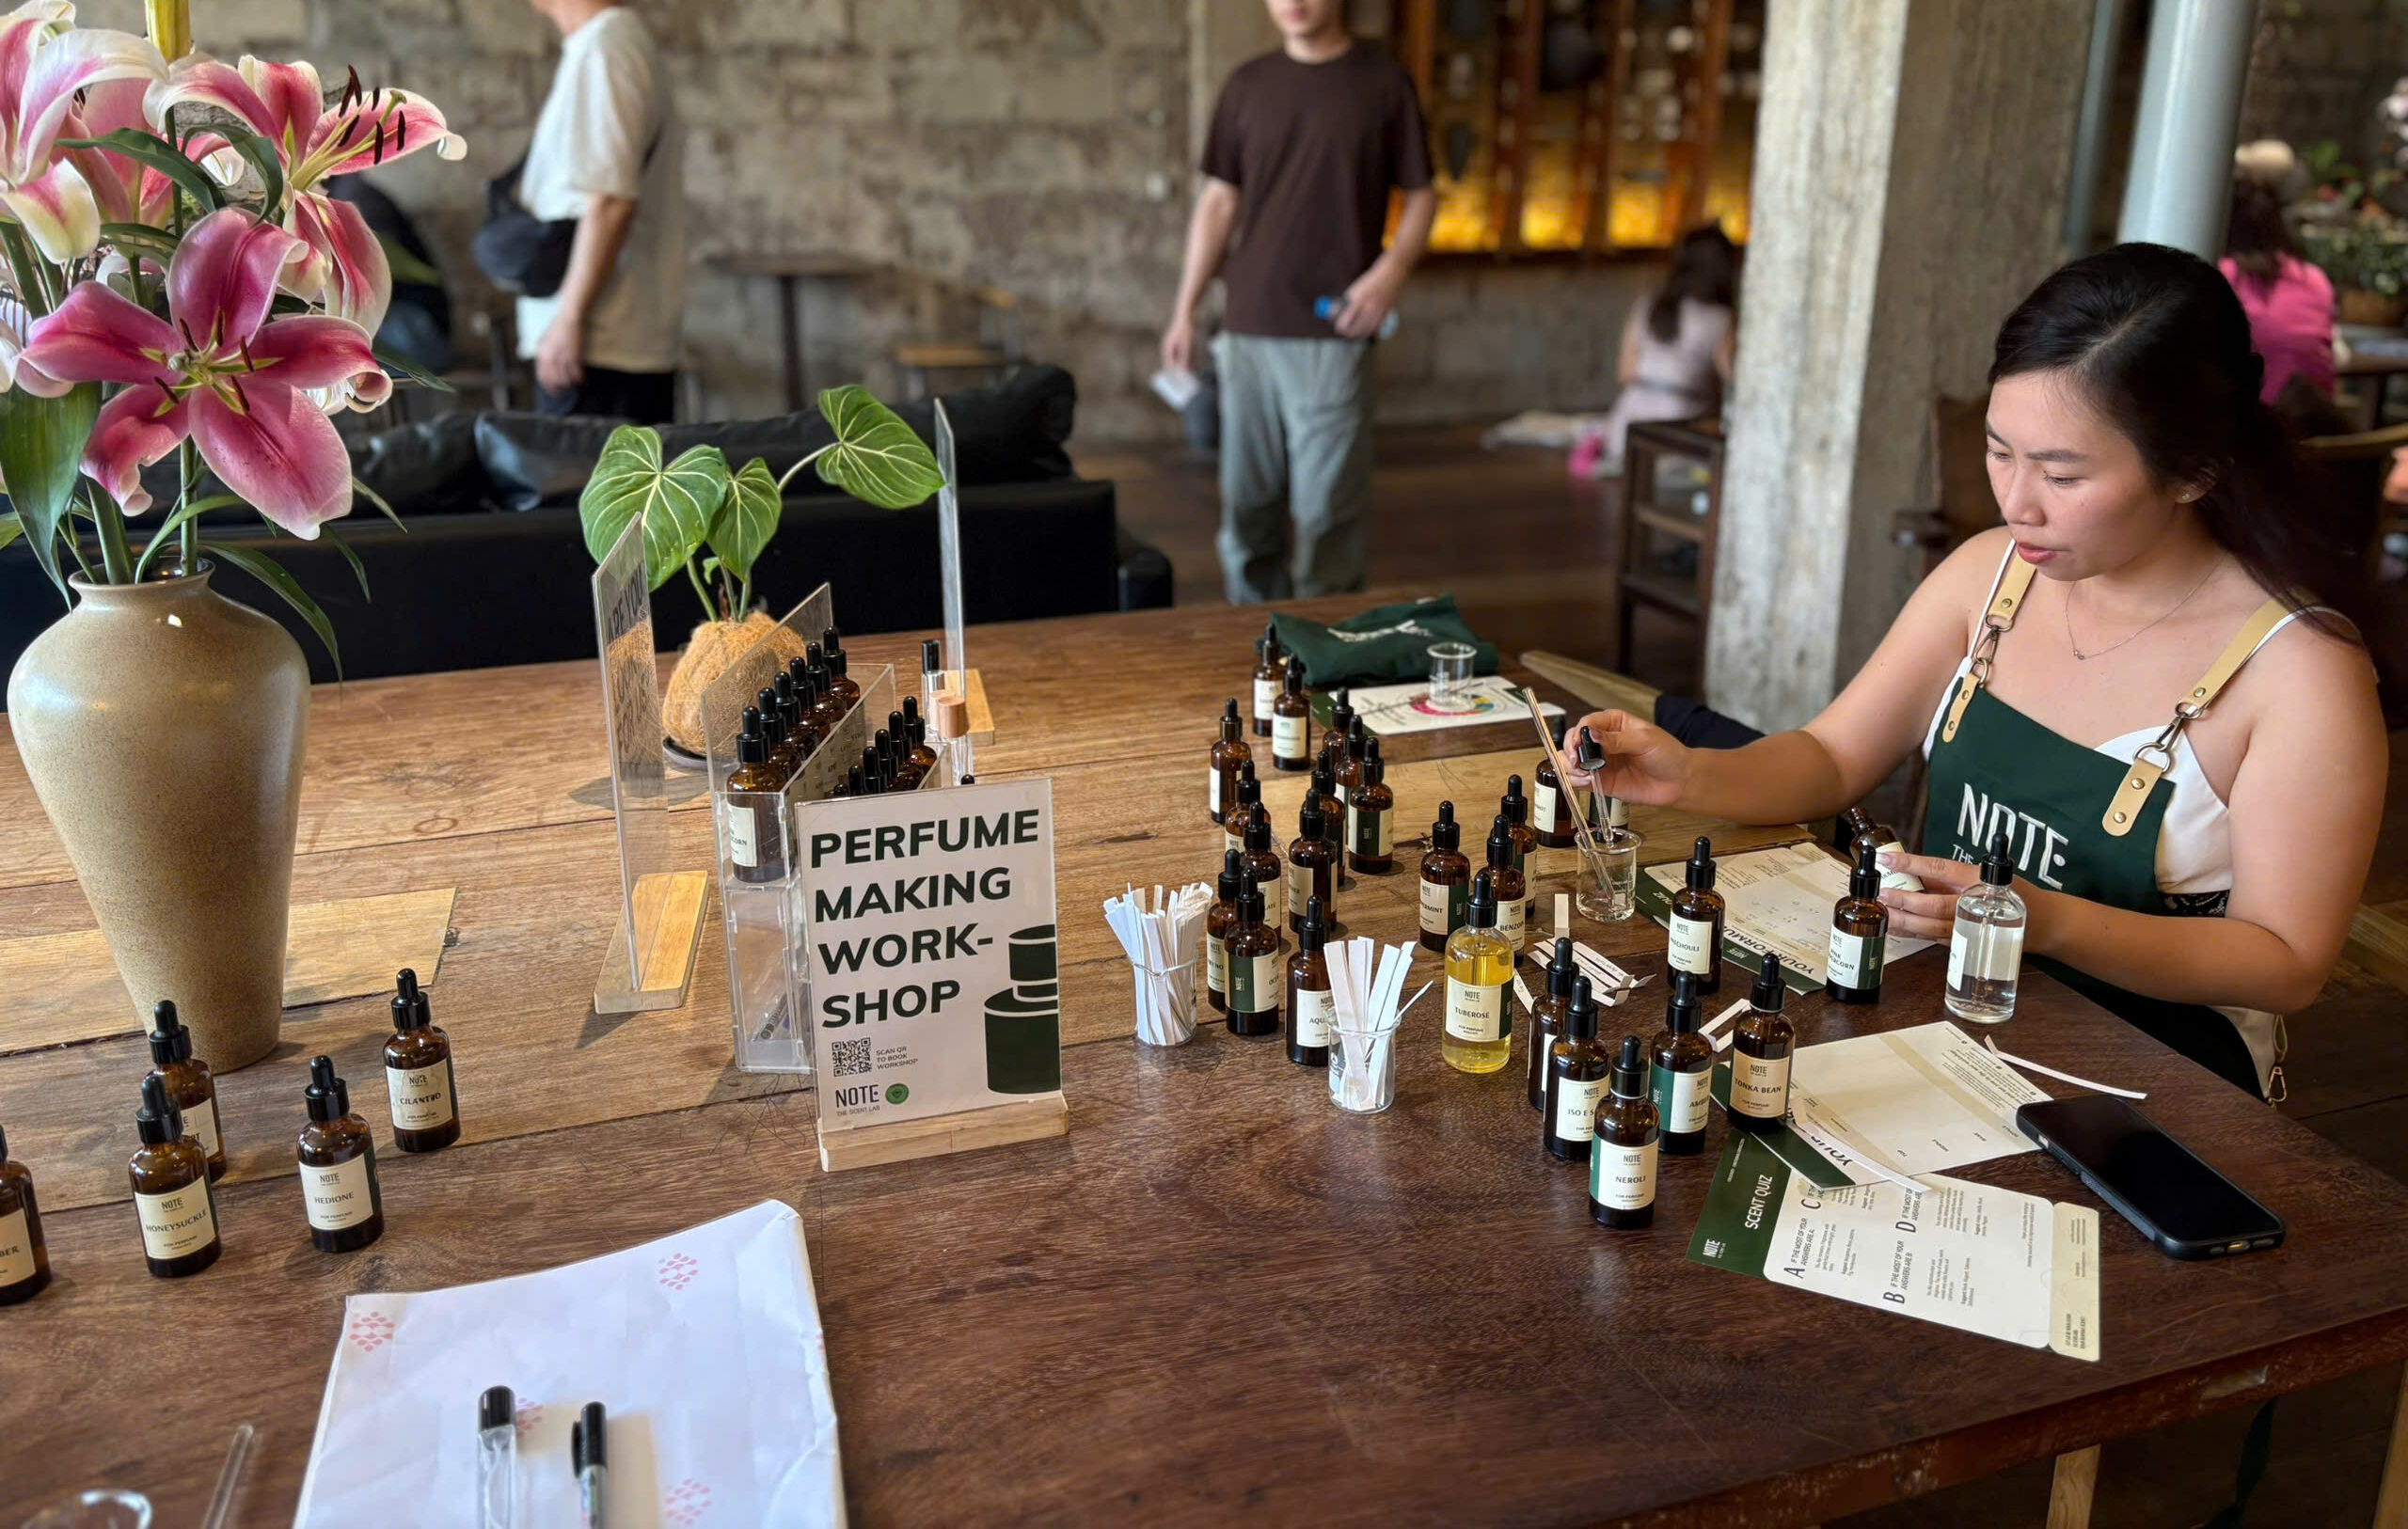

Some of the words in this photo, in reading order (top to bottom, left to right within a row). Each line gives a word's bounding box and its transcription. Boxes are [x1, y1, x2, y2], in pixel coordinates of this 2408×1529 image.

[811, 809, 1039, 868] PERFUME
[1956, 782, 2069, 891] NOTE
[815, 866, 1011, 923] MAKING
[817, 922, 994, 976] WORK-
[1465, 990, 1481, 1000] NOTE
[820, 980, 961, 1029] SHOP
[1455, 1006, 1491, 1019] TUBEROSE
[876, 1048, 895, 1056] SCAN
[877, 1059, 919, 1070] WORKSHOP
[1751, 1064, 1767, 1074] NOTE
[1584, 1087, 1599, 1096] NOTE
[1735, 1079, 1759, 1094] TONKA
[1762, 1085, 1782, 1094] BEAN
[835, 1084, 879, 1108] NOTE
[1568, 1108, 1581, 1116] ISO
[1624, 1155, 1640, 1163] NOTE
[320, 1173, 340, 1184] NOTE
[1615, 1175, 1647, 1184] NEROLI
[1754, 1174, 1773, 1198] QUIZ
[161, 1197, 183, 1209] NOTE
[314, 1190, 355, 1205] HEDIONE
[1800, 1198, 1822, 1210] C
[1745, 1196, 1766, 1230] SCENT
[146, 1208, 208, 1234] HONEYSUCKLE
[1894, 1221, 1917, 1234] D
[1703, 1238, 1720, 1258] NOTE
[1783, 1267, 1805, 1280] A
[1882, 1291, 1905, 1304] B
